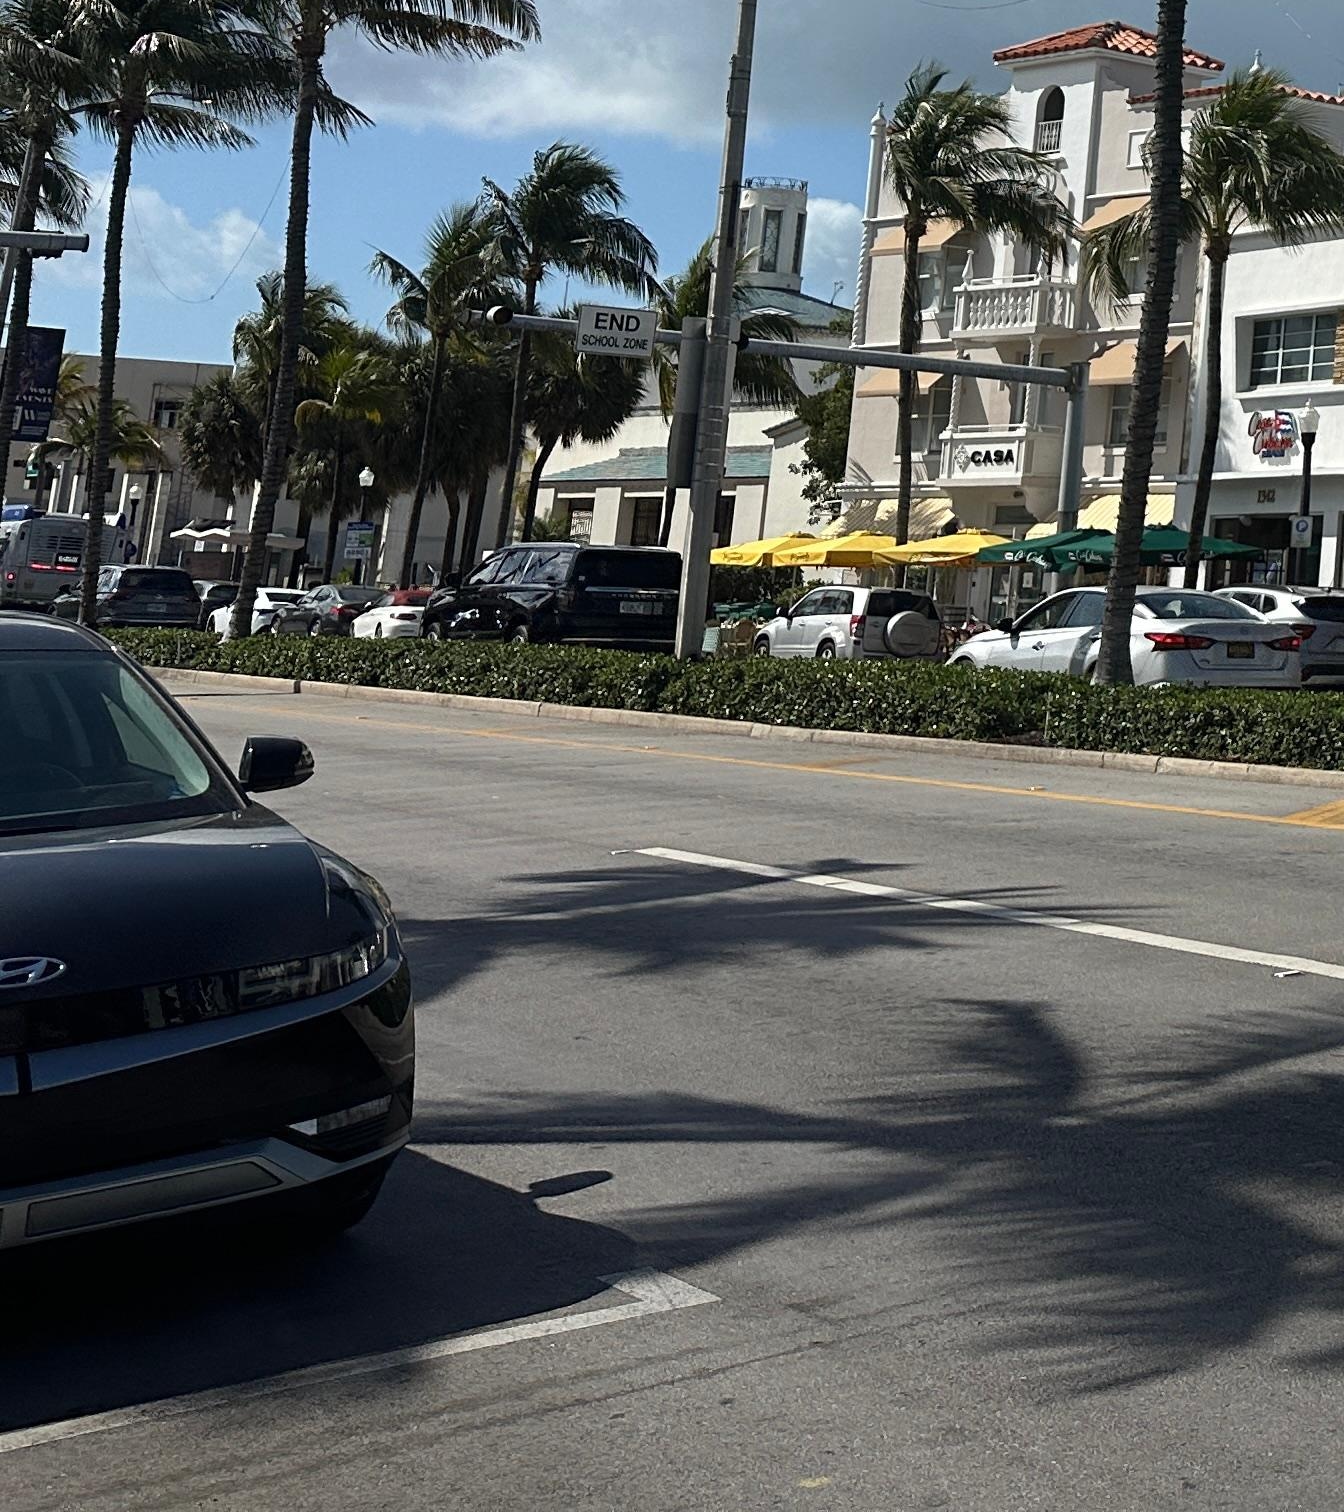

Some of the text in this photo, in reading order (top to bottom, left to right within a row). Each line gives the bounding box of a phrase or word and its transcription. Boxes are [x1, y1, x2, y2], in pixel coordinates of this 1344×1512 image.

[594, 312, 641, 332] END
[581, 334, 649, 350] SCHOOL ZONE
[970, 449, 1014, 465] CASA
